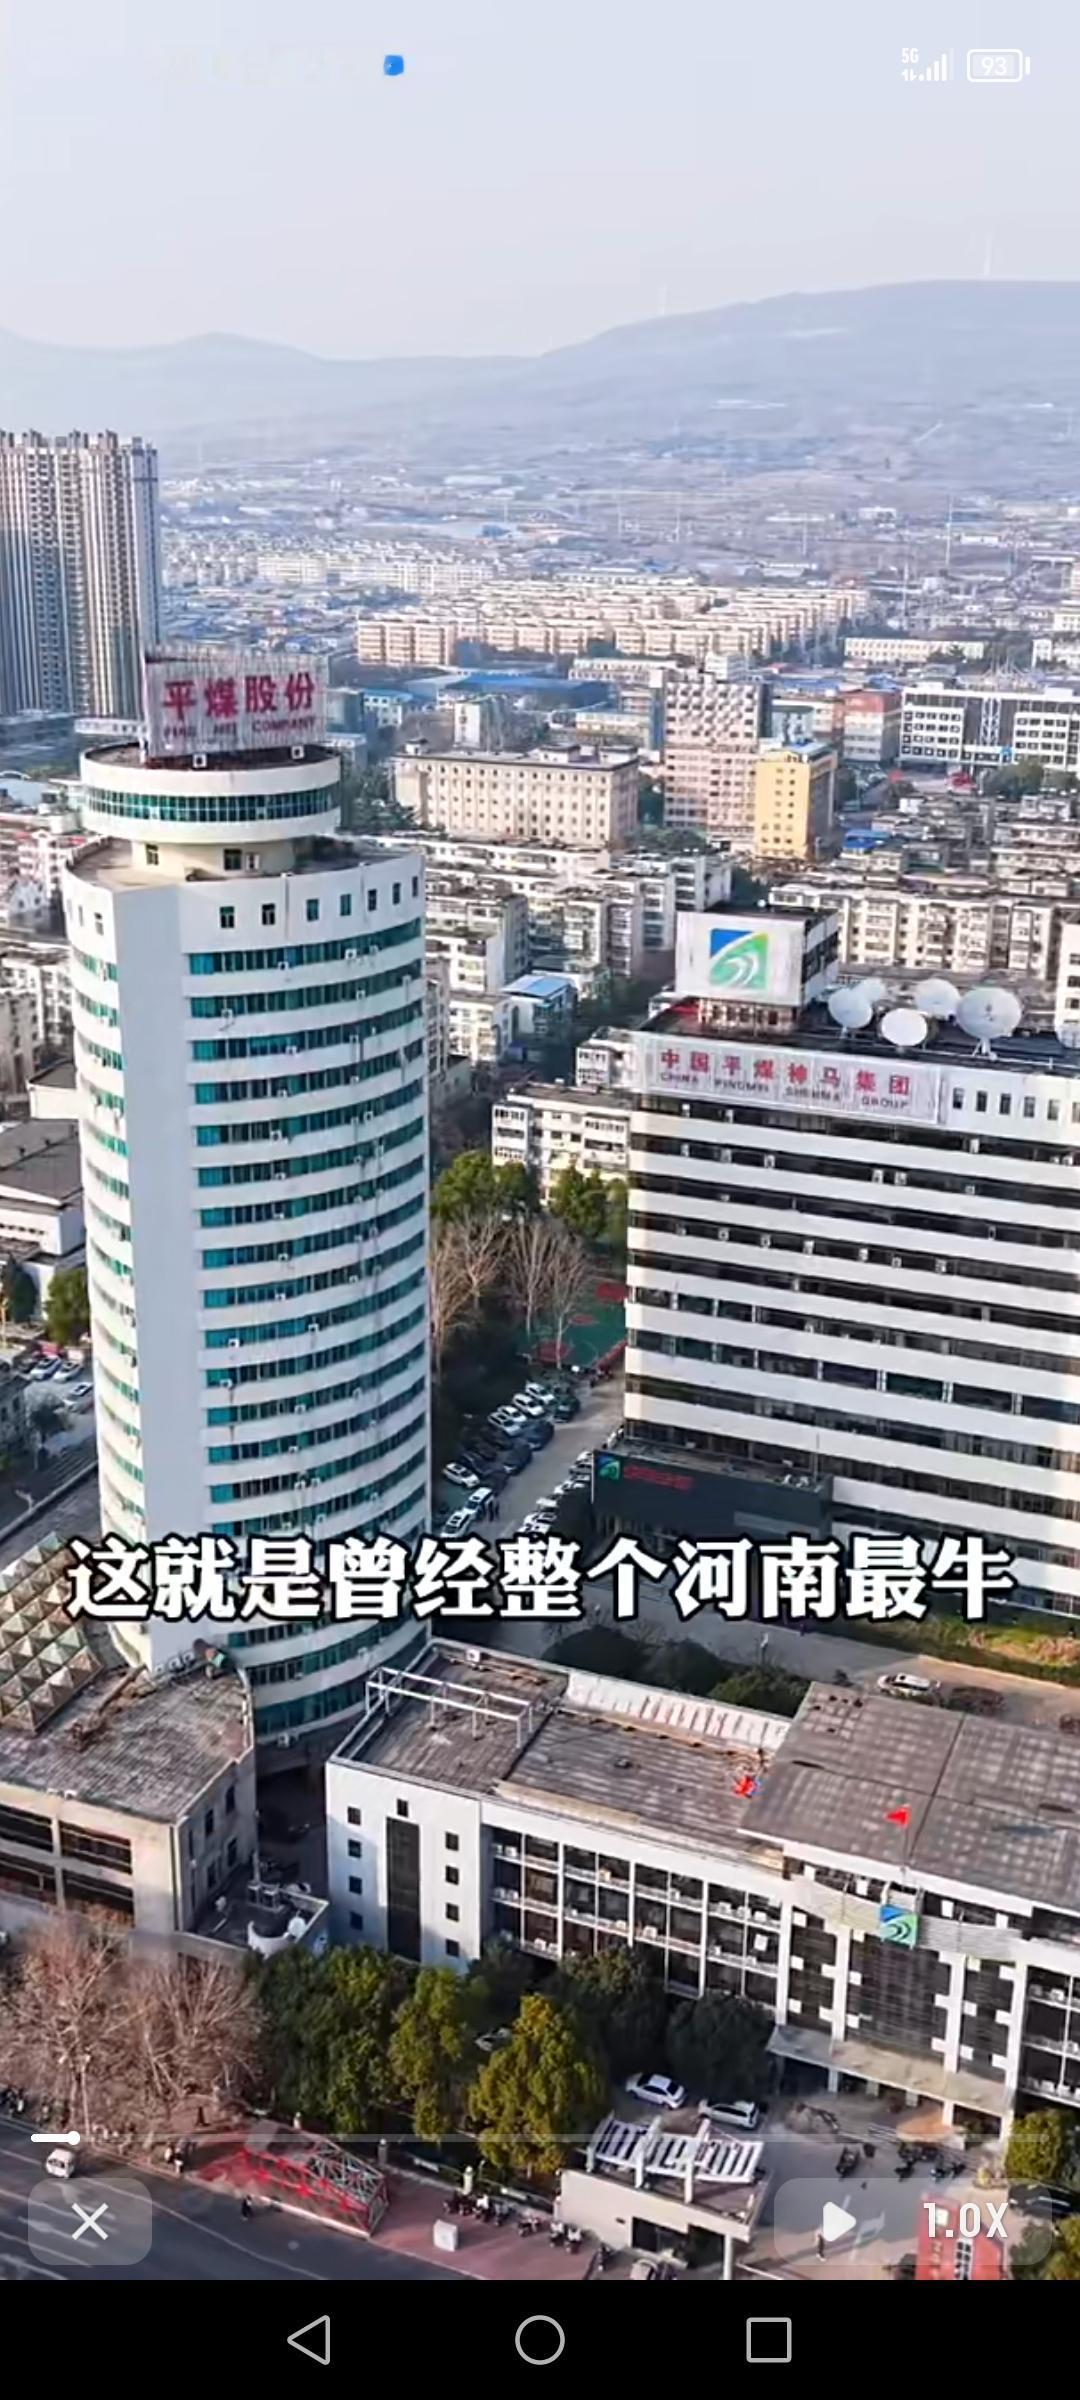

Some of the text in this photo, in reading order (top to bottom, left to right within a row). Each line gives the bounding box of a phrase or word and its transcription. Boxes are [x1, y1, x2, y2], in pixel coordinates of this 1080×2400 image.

[163, 672, 314, 720] 平煤股份
[252, 716, 315, 733] COMPANY
[660, 1048, 910, 1095] 中国平煤神马集团
